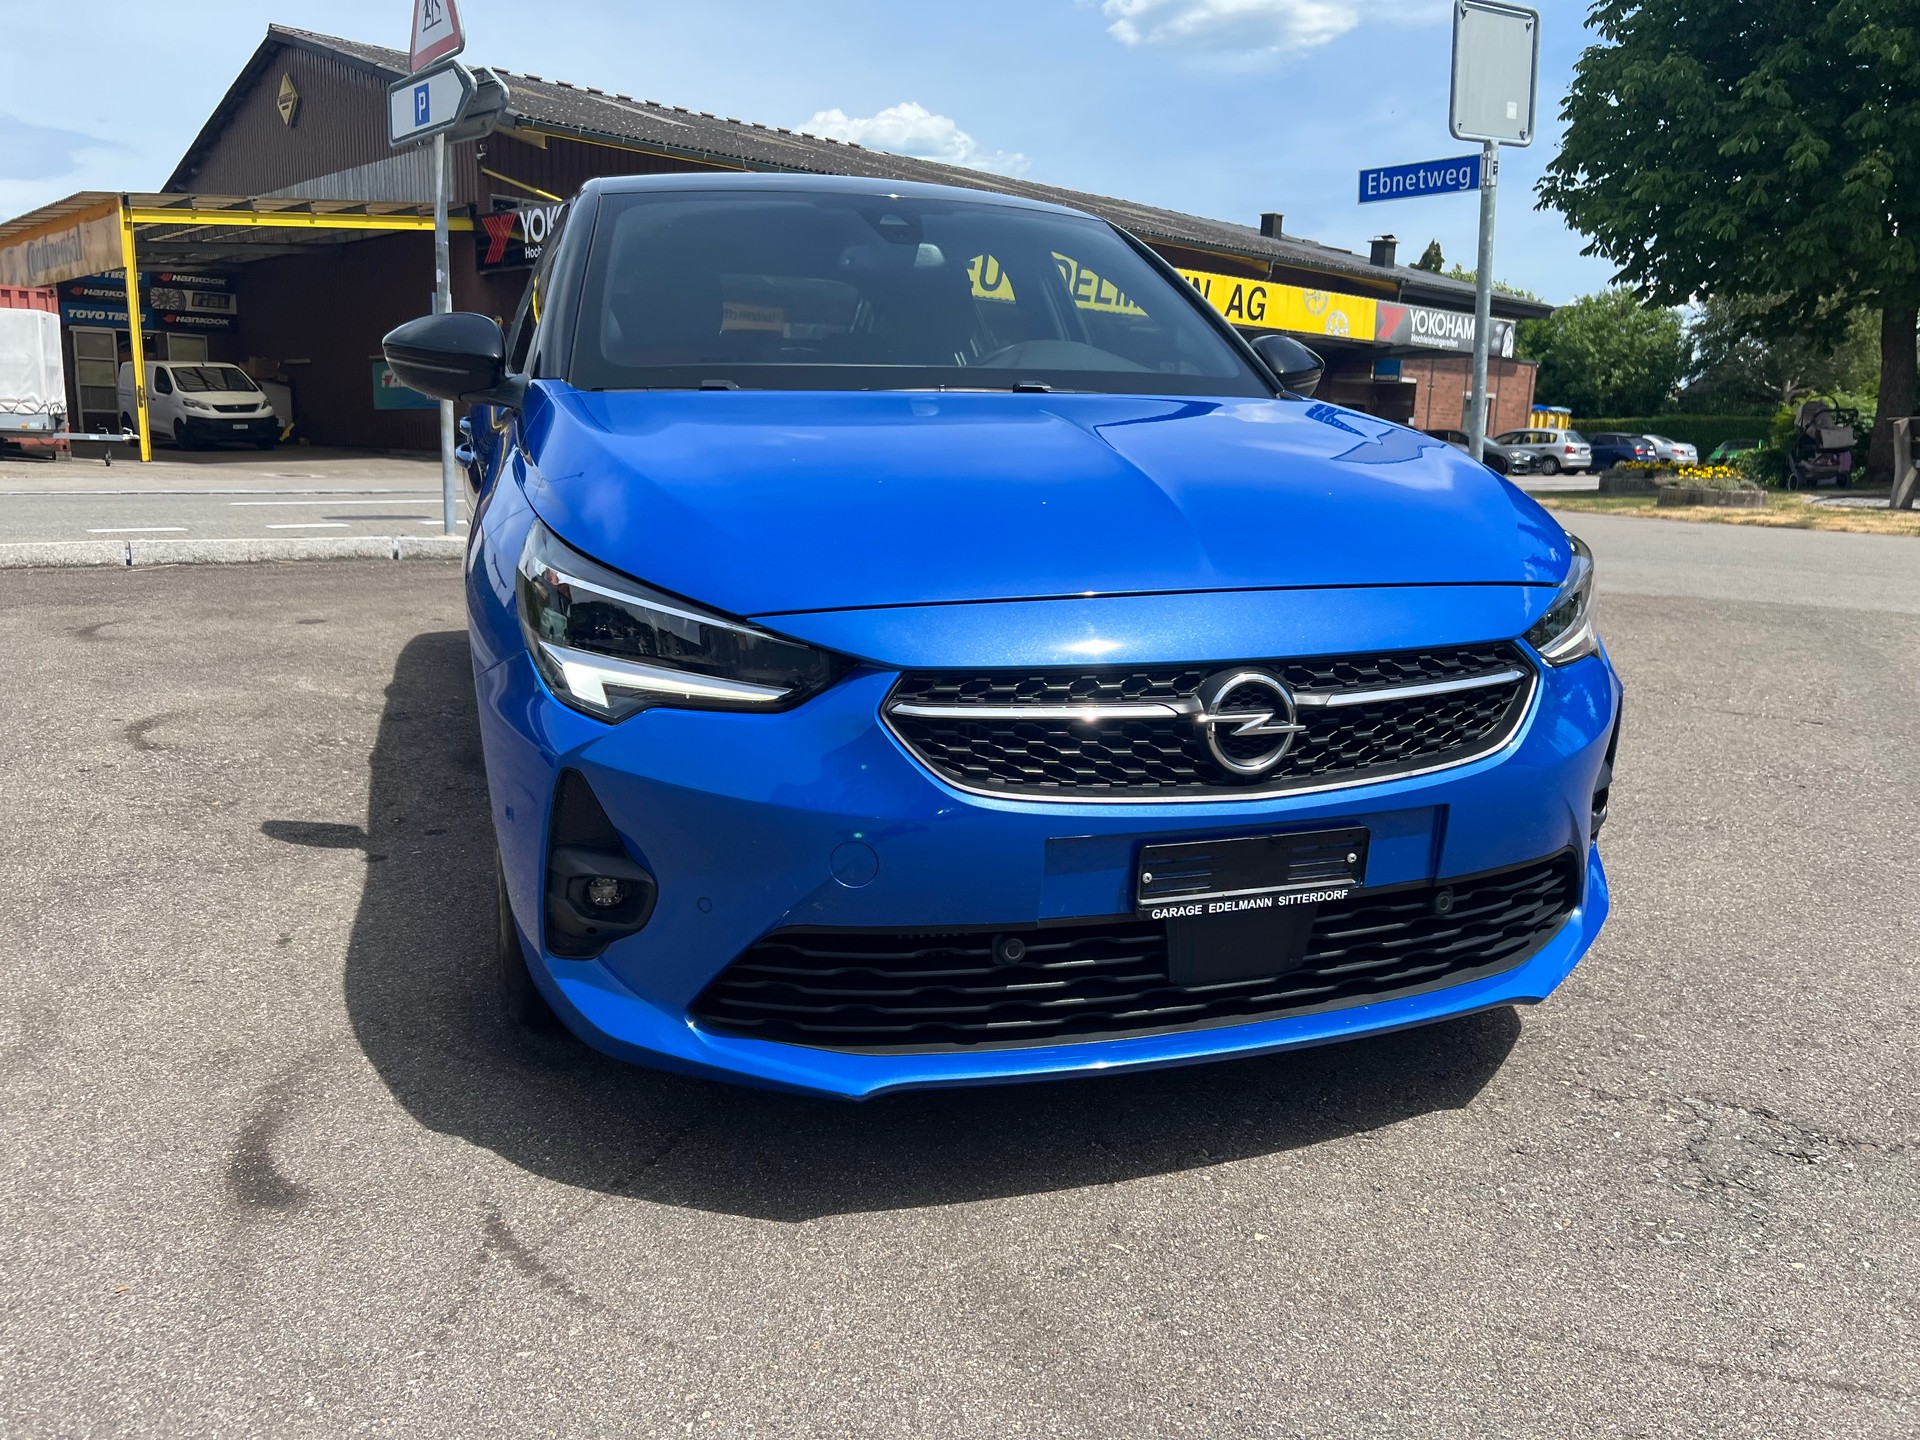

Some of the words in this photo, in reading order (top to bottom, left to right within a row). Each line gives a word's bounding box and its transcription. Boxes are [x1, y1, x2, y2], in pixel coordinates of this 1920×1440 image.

[418, 91, 427, 120] P
[1367, 165, 1471, 195] Ebnetweg
[519, 203, 566, 244] YOK
[83, 288, 128, 298] HANKO
[1224, 283, 1267, 321] AG
[107, 311, 147, 322] TIRS
[1409, 308, 1476, 341] YOKOHAM
[1151, 904, 1203, 920] GARAGE
[1208, 897, 1273, 914] EDELMANN
[1278, 889, 1349, 906] SITTERDORF
